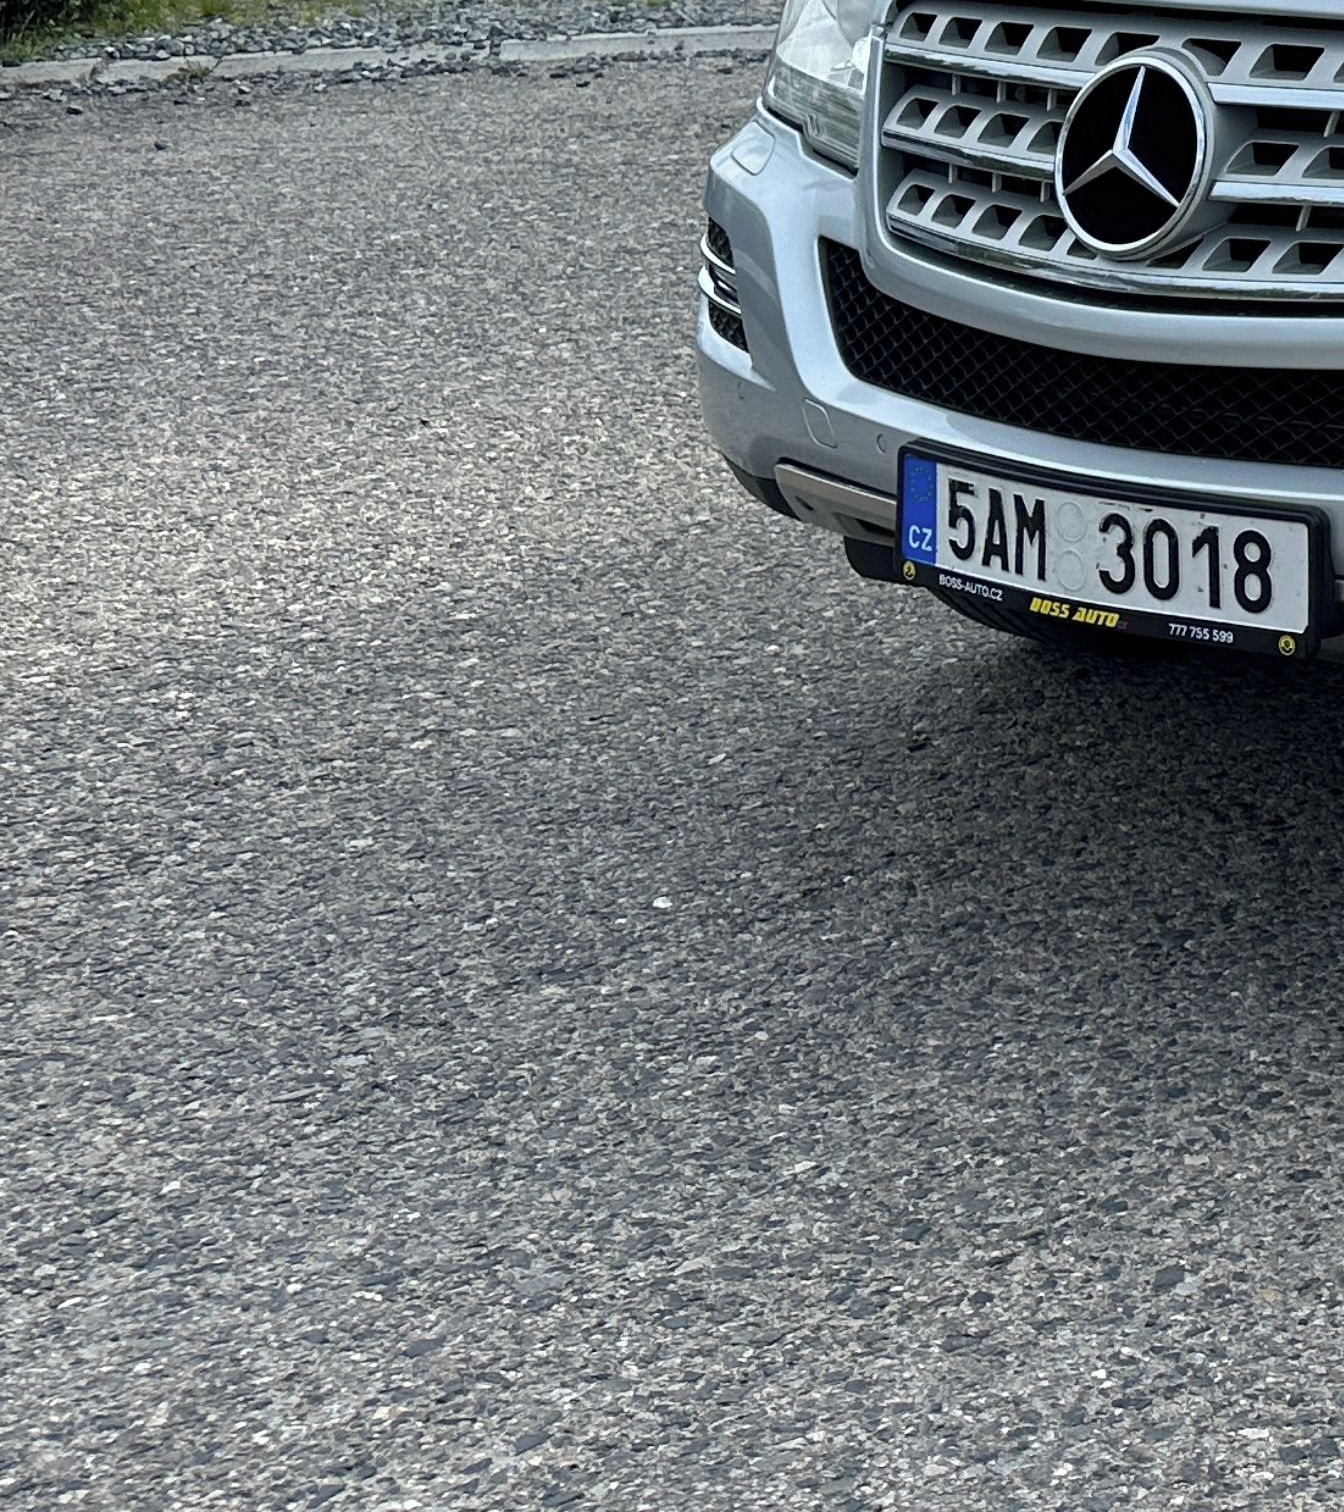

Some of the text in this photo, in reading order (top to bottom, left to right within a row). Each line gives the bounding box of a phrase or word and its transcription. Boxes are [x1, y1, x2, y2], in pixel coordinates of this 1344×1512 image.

[908, 525, 933, 552] CZ
[948, 478, 1272, 614] 5AM 3018
[939, 574, 1004, 602] BOSS-AUTO.CZ
[1029, 597, 1071, 619] BOSS
[1072, 607, 1120, 628] AUTO
[1168, 623, 1234, 644] 777 755 599
